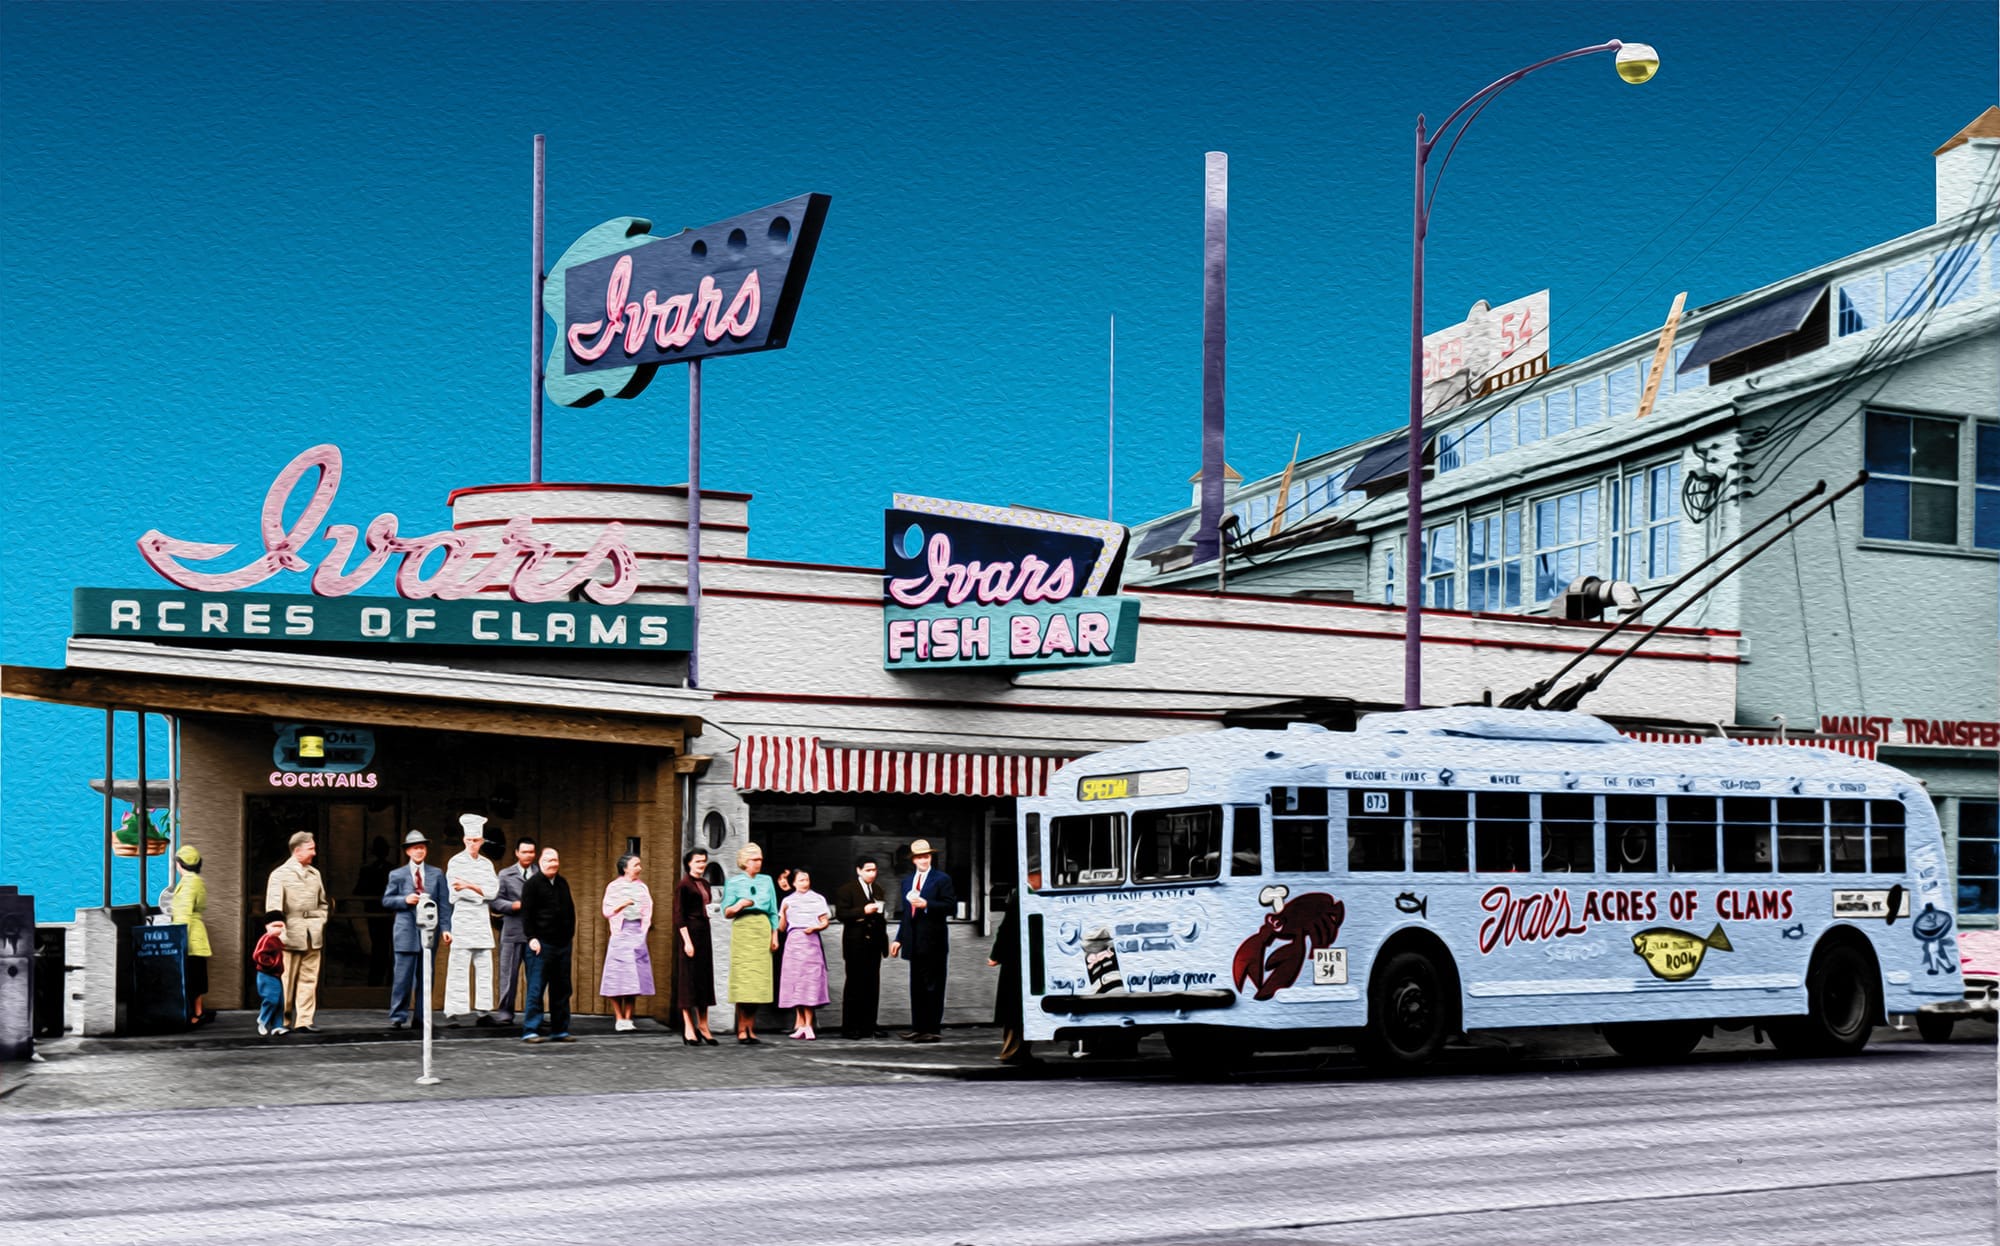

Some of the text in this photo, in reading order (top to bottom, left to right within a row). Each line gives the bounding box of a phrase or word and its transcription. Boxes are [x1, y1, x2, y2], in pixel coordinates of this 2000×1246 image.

[567, 254, 761, 361] Ivars
[1501, 307, 1533, 358] 54
[137, 443, 637, 606] Ivars
[889, 532, 1075, 607] Ivars
[110, 599, 668, 645] ACRES OF CLAMS
[888, 611, 1113, 661] FISH BAR
[269, 771, 378, 789] COCKTAILS
[1345, 771, 1387, 782] WELCOME
[1366, 795, 1387, 809] 873
[1479, 886, 1793, 954] Ivar's ACRES OF CLAMS
[1317, 951, 1342, 962] PIER
[1322, 964, 1335, 977] 54
